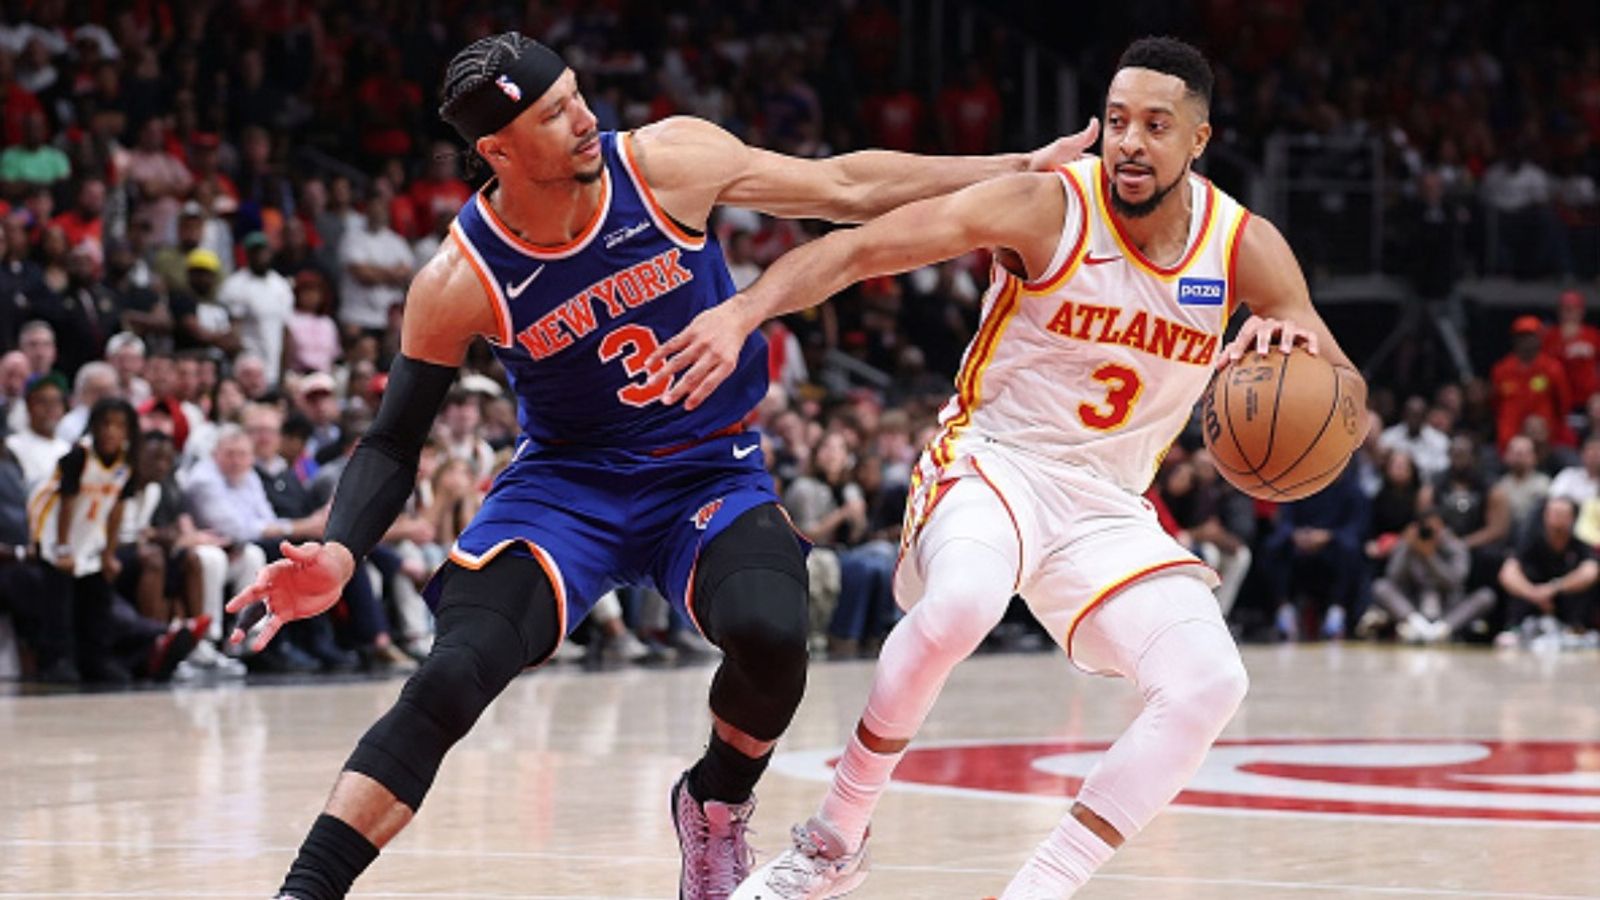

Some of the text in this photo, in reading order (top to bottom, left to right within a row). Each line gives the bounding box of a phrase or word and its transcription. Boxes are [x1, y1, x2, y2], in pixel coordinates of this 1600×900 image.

[516, 248, 693, 360] NEW YORK
[1181, 284, 1220, 298] paze
[598, 323, 675, 407] 3
[1046, 300, 1218, 366] ATLANTA
[1077, 361, 1143, 432] 3
